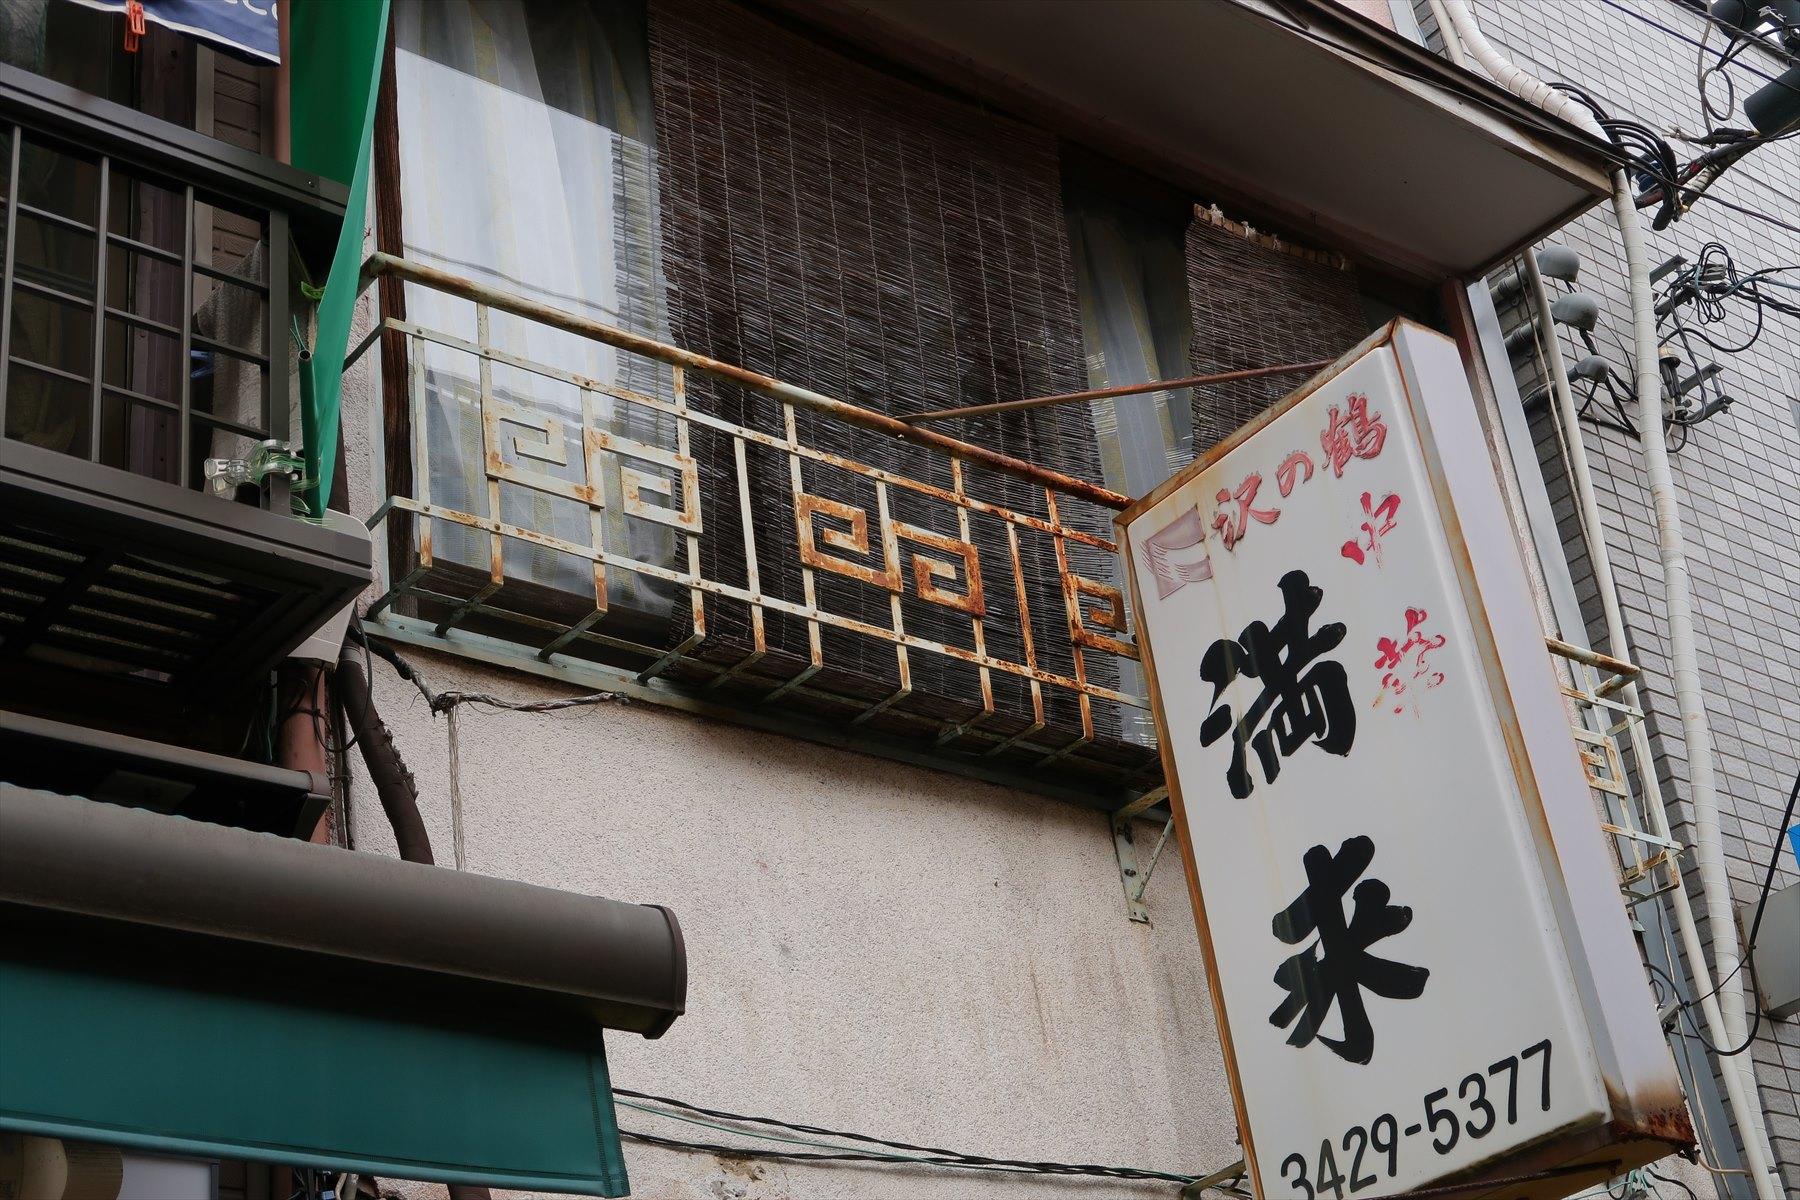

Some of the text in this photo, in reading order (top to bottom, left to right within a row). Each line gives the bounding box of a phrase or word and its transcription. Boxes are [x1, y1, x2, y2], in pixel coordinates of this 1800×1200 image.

[1211, 392, 1388, 550] 沢の鶴
[1200, 570, 1430, 1065] 満来
[1281, 1039, 1551, 1200] 3429-5377
